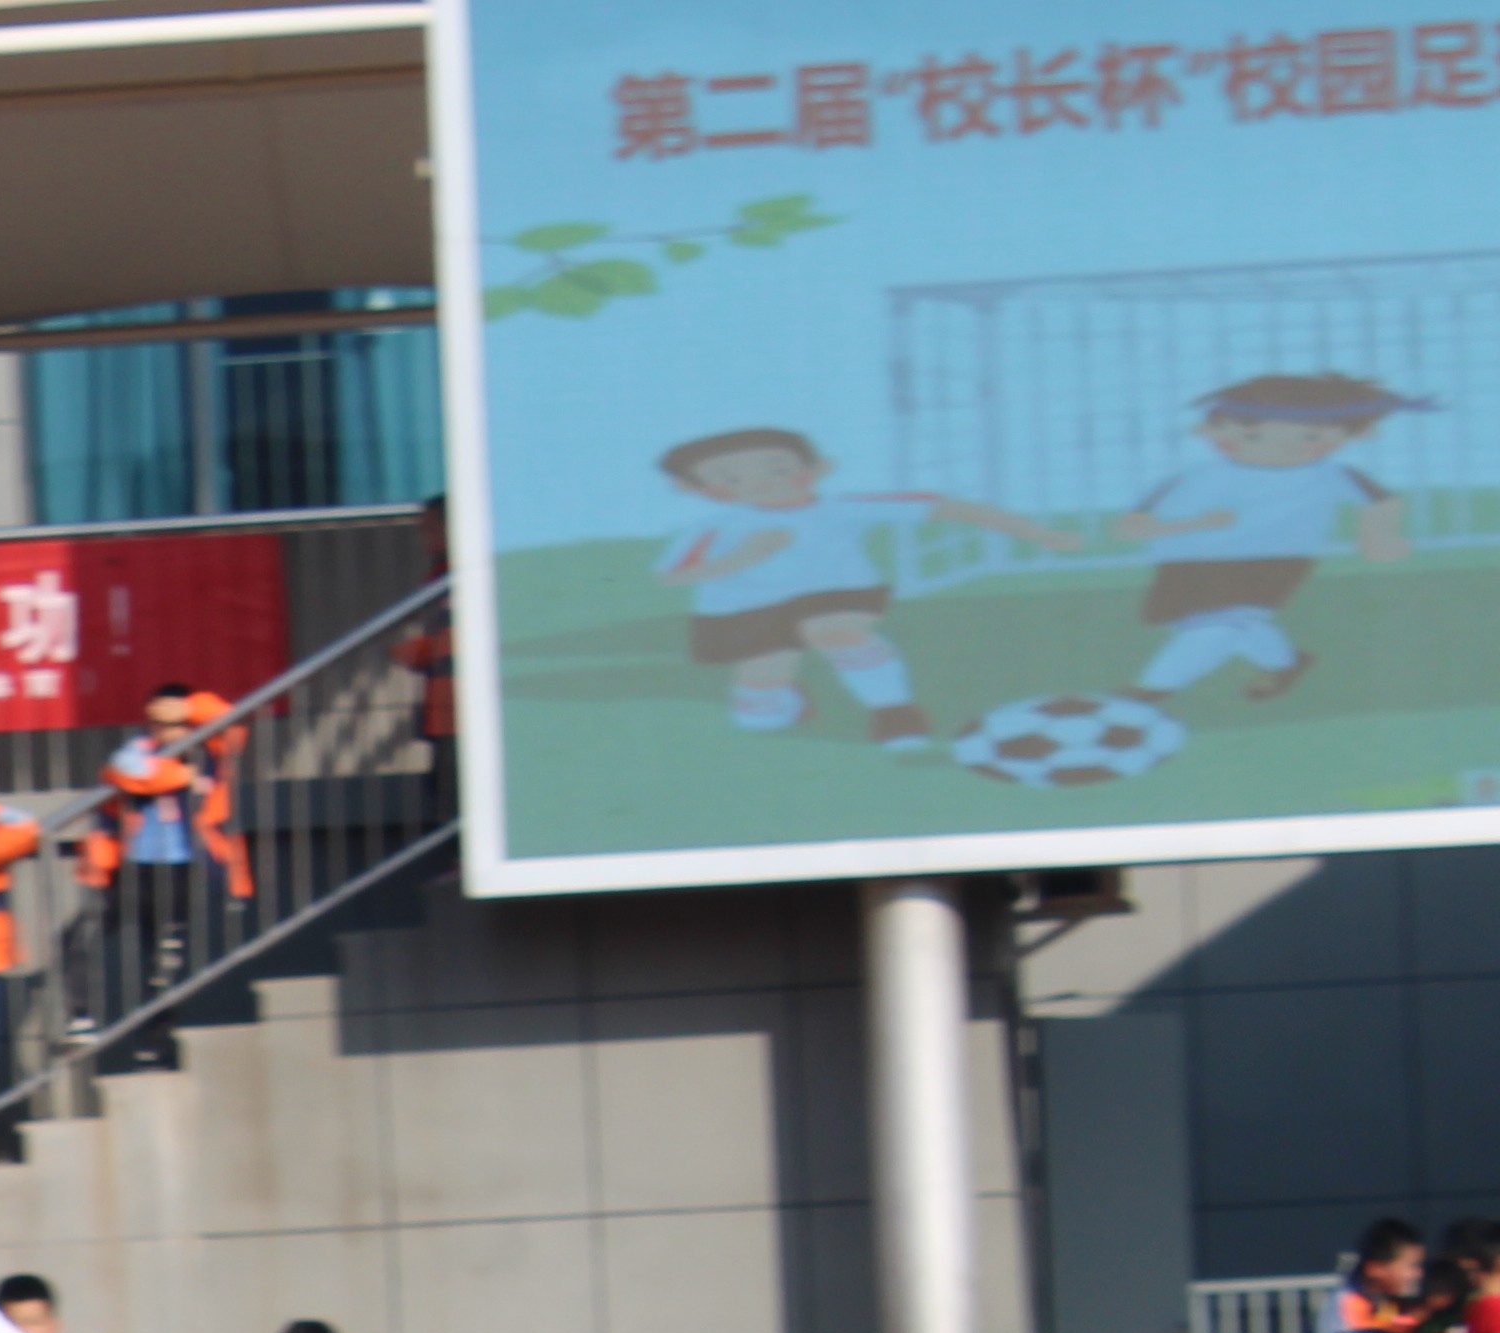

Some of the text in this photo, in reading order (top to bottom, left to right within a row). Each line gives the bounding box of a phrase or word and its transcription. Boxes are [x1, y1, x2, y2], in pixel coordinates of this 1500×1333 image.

[612, 22, 1500, 160] 第二届“校长杯”校园足
